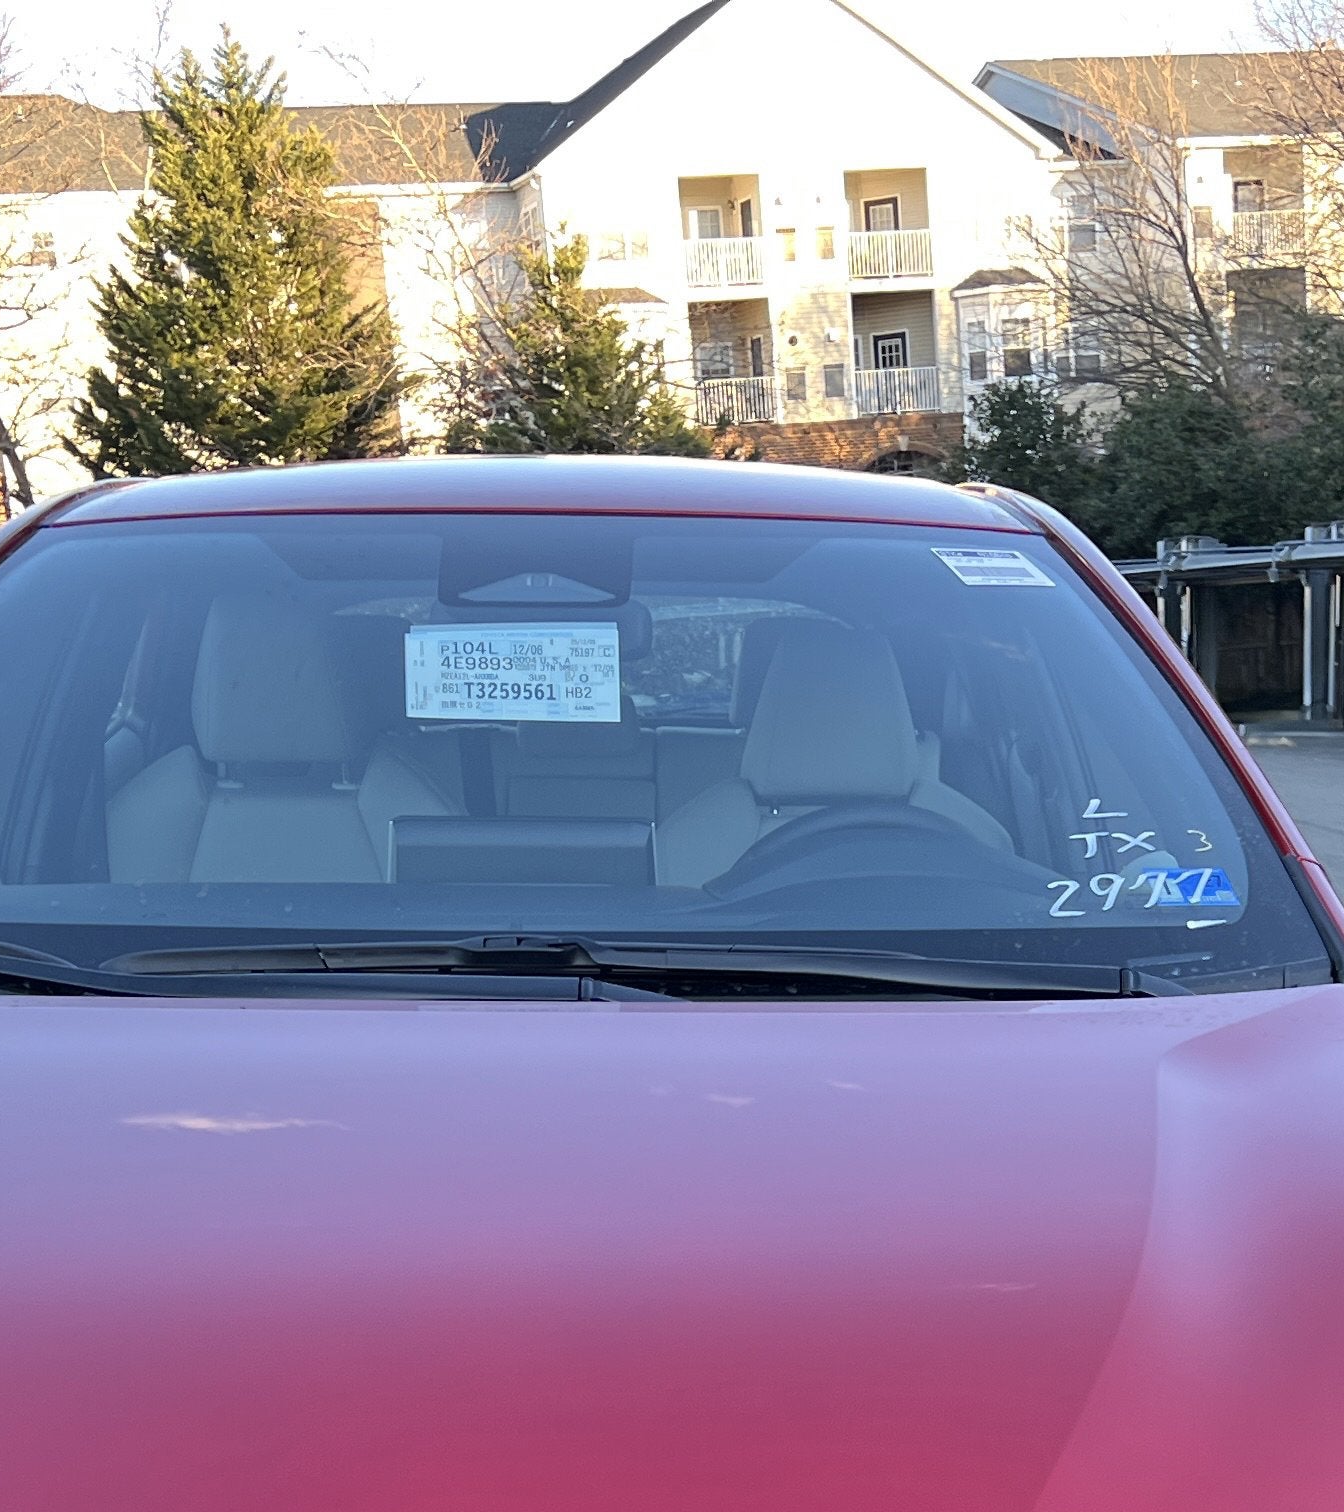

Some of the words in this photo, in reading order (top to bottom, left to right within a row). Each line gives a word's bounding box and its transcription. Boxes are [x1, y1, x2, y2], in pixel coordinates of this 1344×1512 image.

[440, 655, 514, 671] 4E9893
[463, 681, 557, 701] T3259561
[565, 686, 592, 699] HB2
